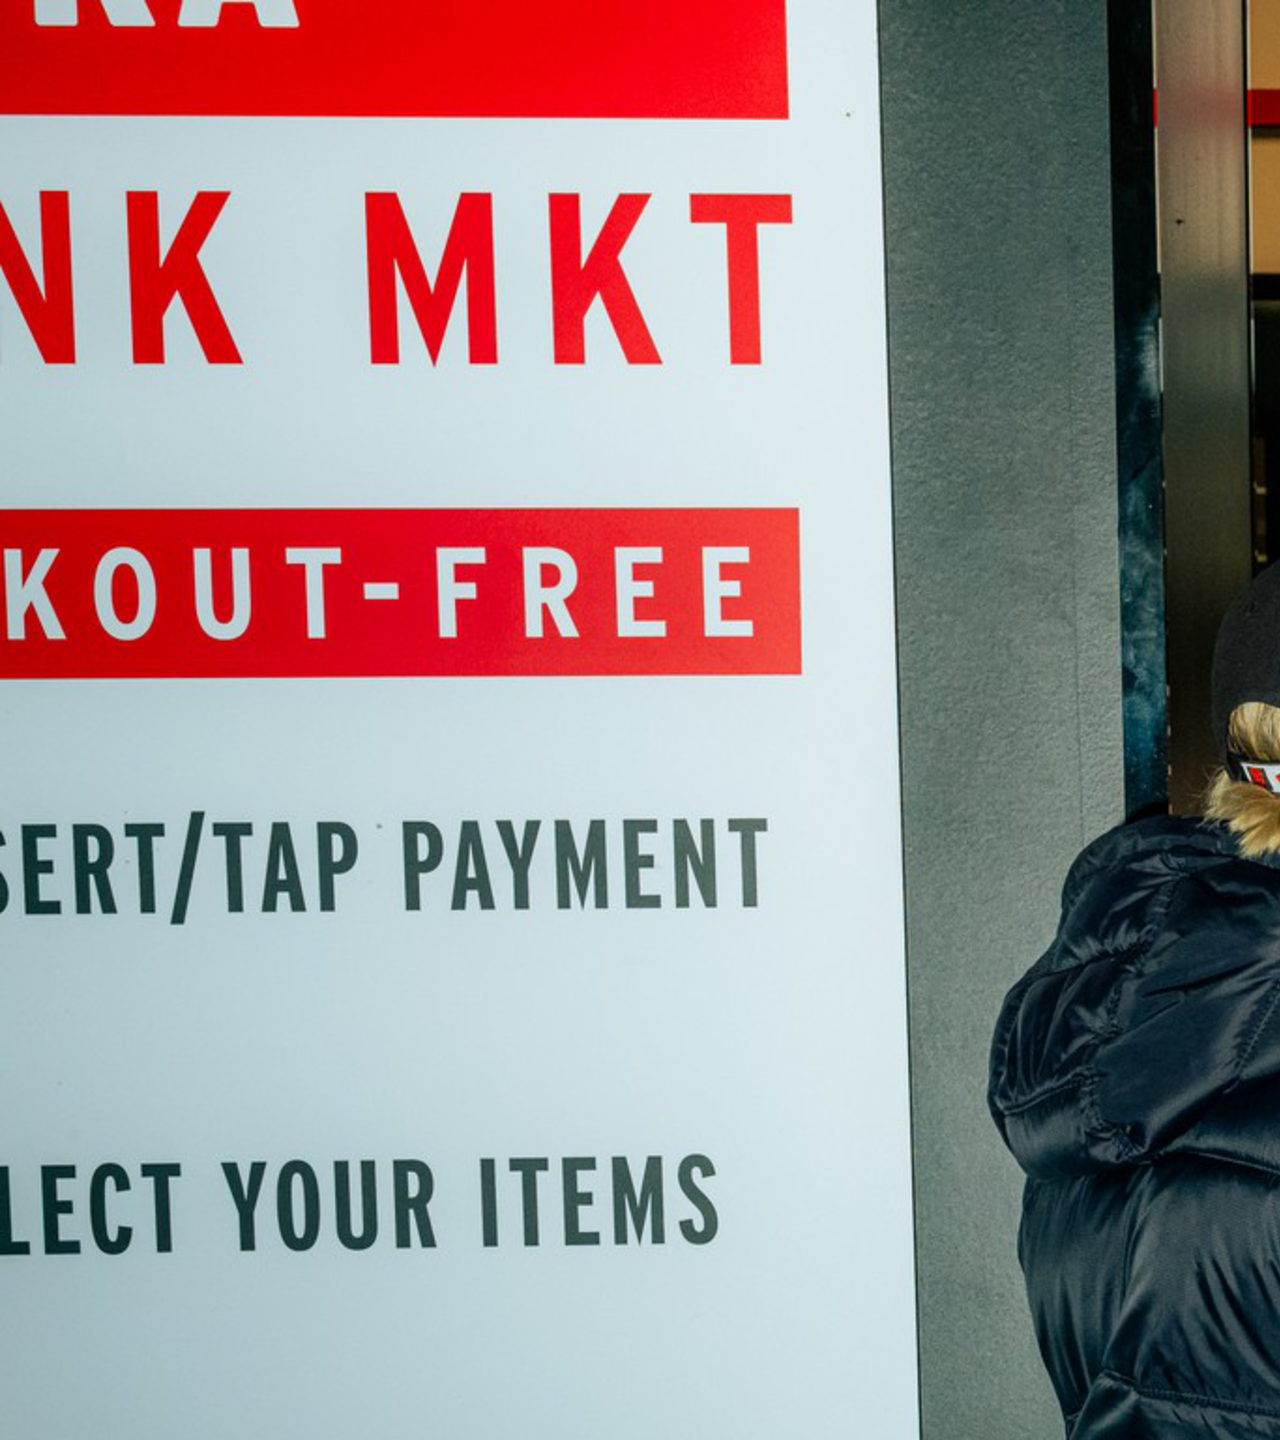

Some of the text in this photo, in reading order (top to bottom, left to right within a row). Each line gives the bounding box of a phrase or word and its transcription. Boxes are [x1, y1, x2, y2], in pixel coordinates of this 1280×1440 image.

[0, 191, 793, 367] NK MKT
[3, 546, 755, 640] KOUT-FREE
[402, 818, 768, 911] PAYMENT
[0, 1153, 719, 1256] LECT YOUR ITEMS
